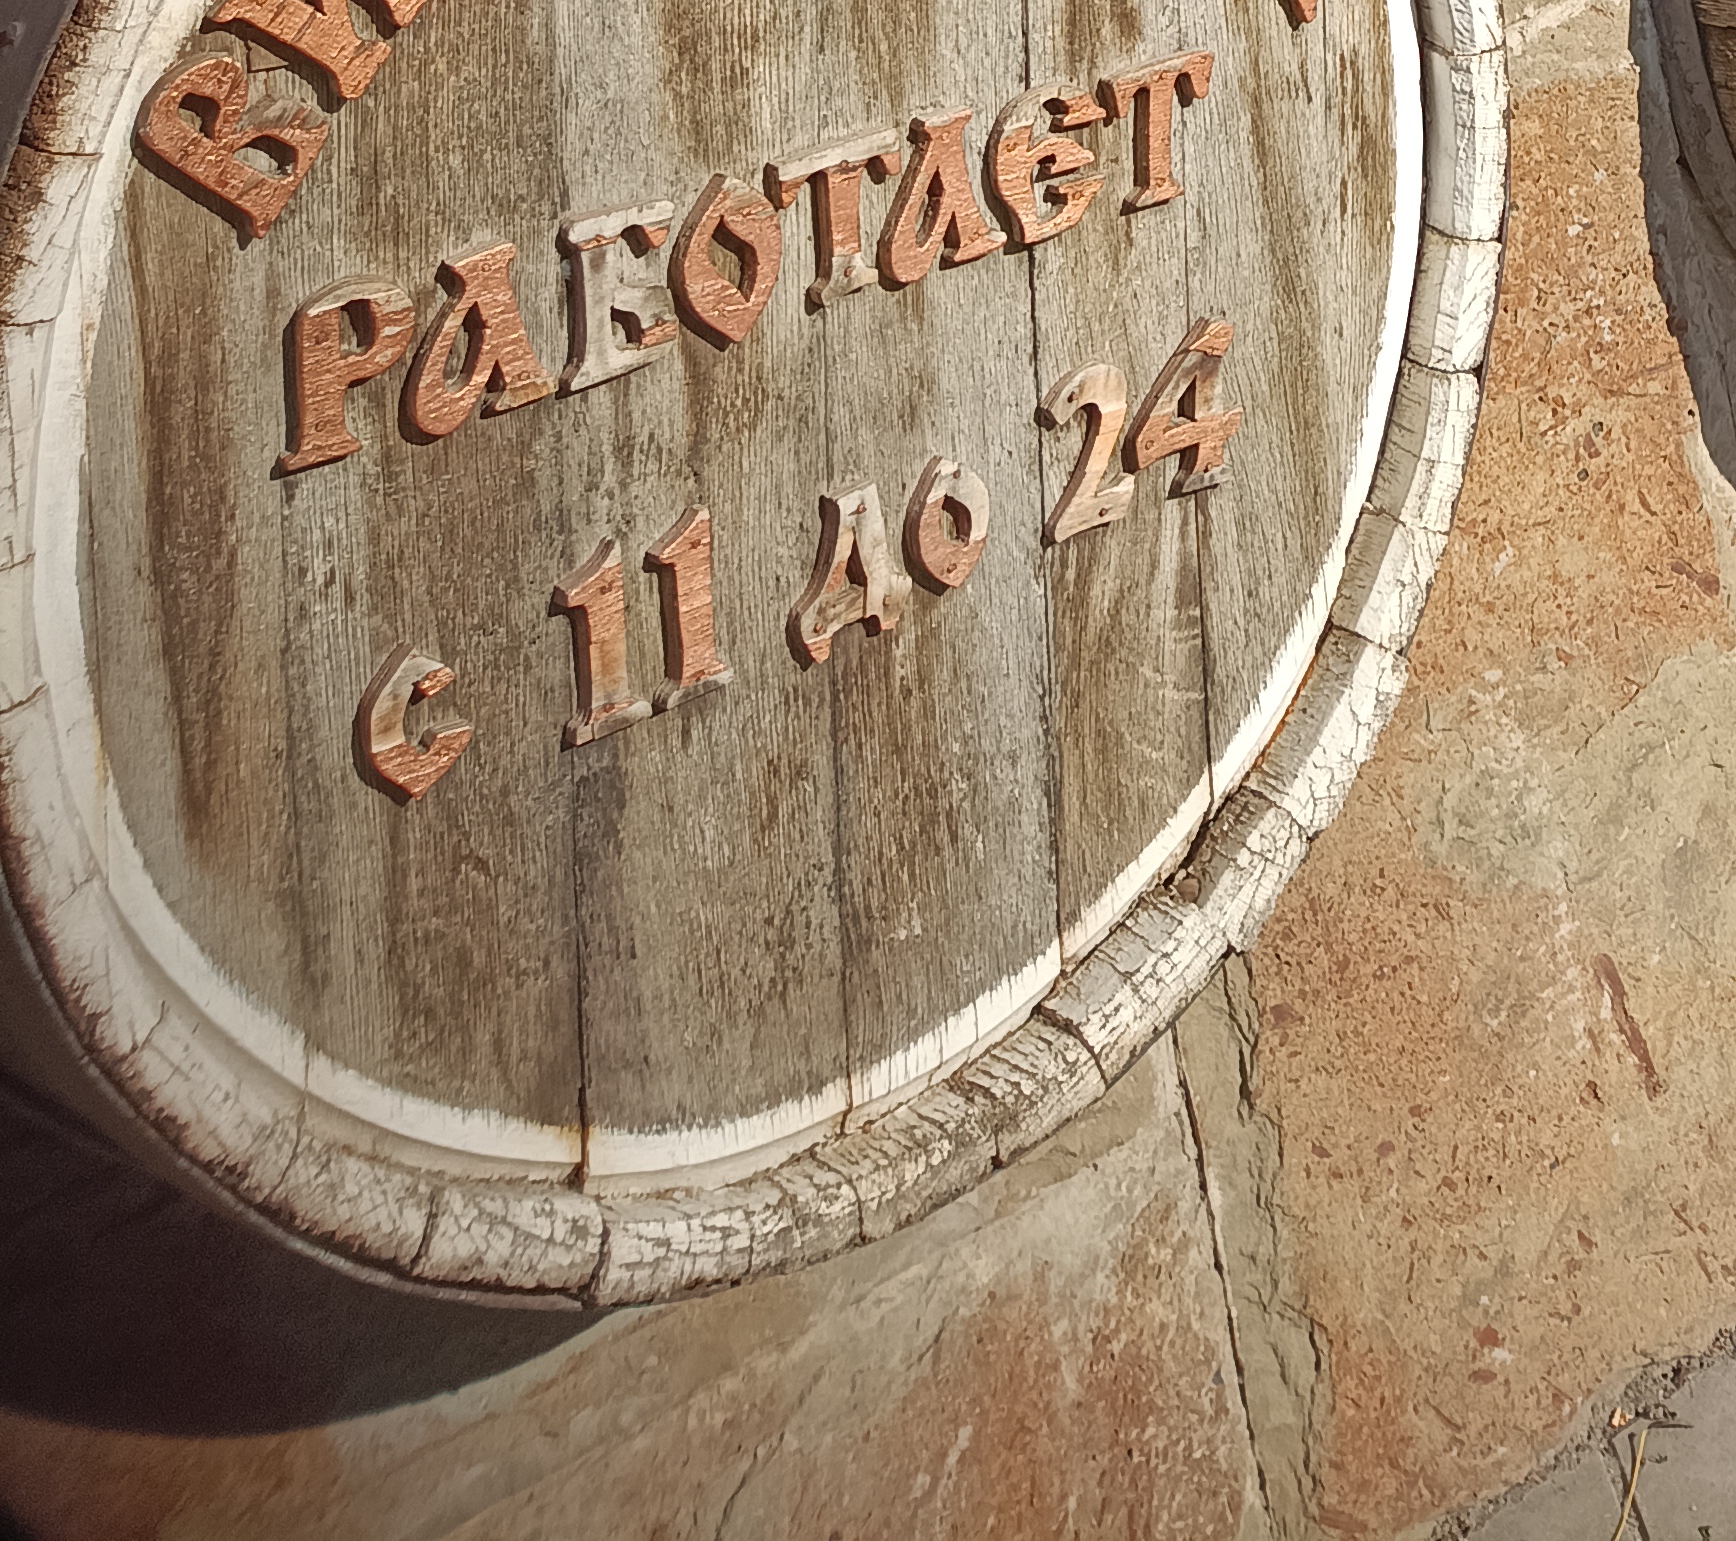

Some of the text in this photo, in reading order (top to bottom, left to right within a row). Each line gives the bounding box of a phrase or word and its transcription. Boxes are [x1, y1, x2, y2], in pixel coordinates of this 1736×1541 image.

[272, 49, 1216, 479] РАБОТАЕТ
[549, 503, 734, 749] 11
[1036, 317, 1243, 545] 24
